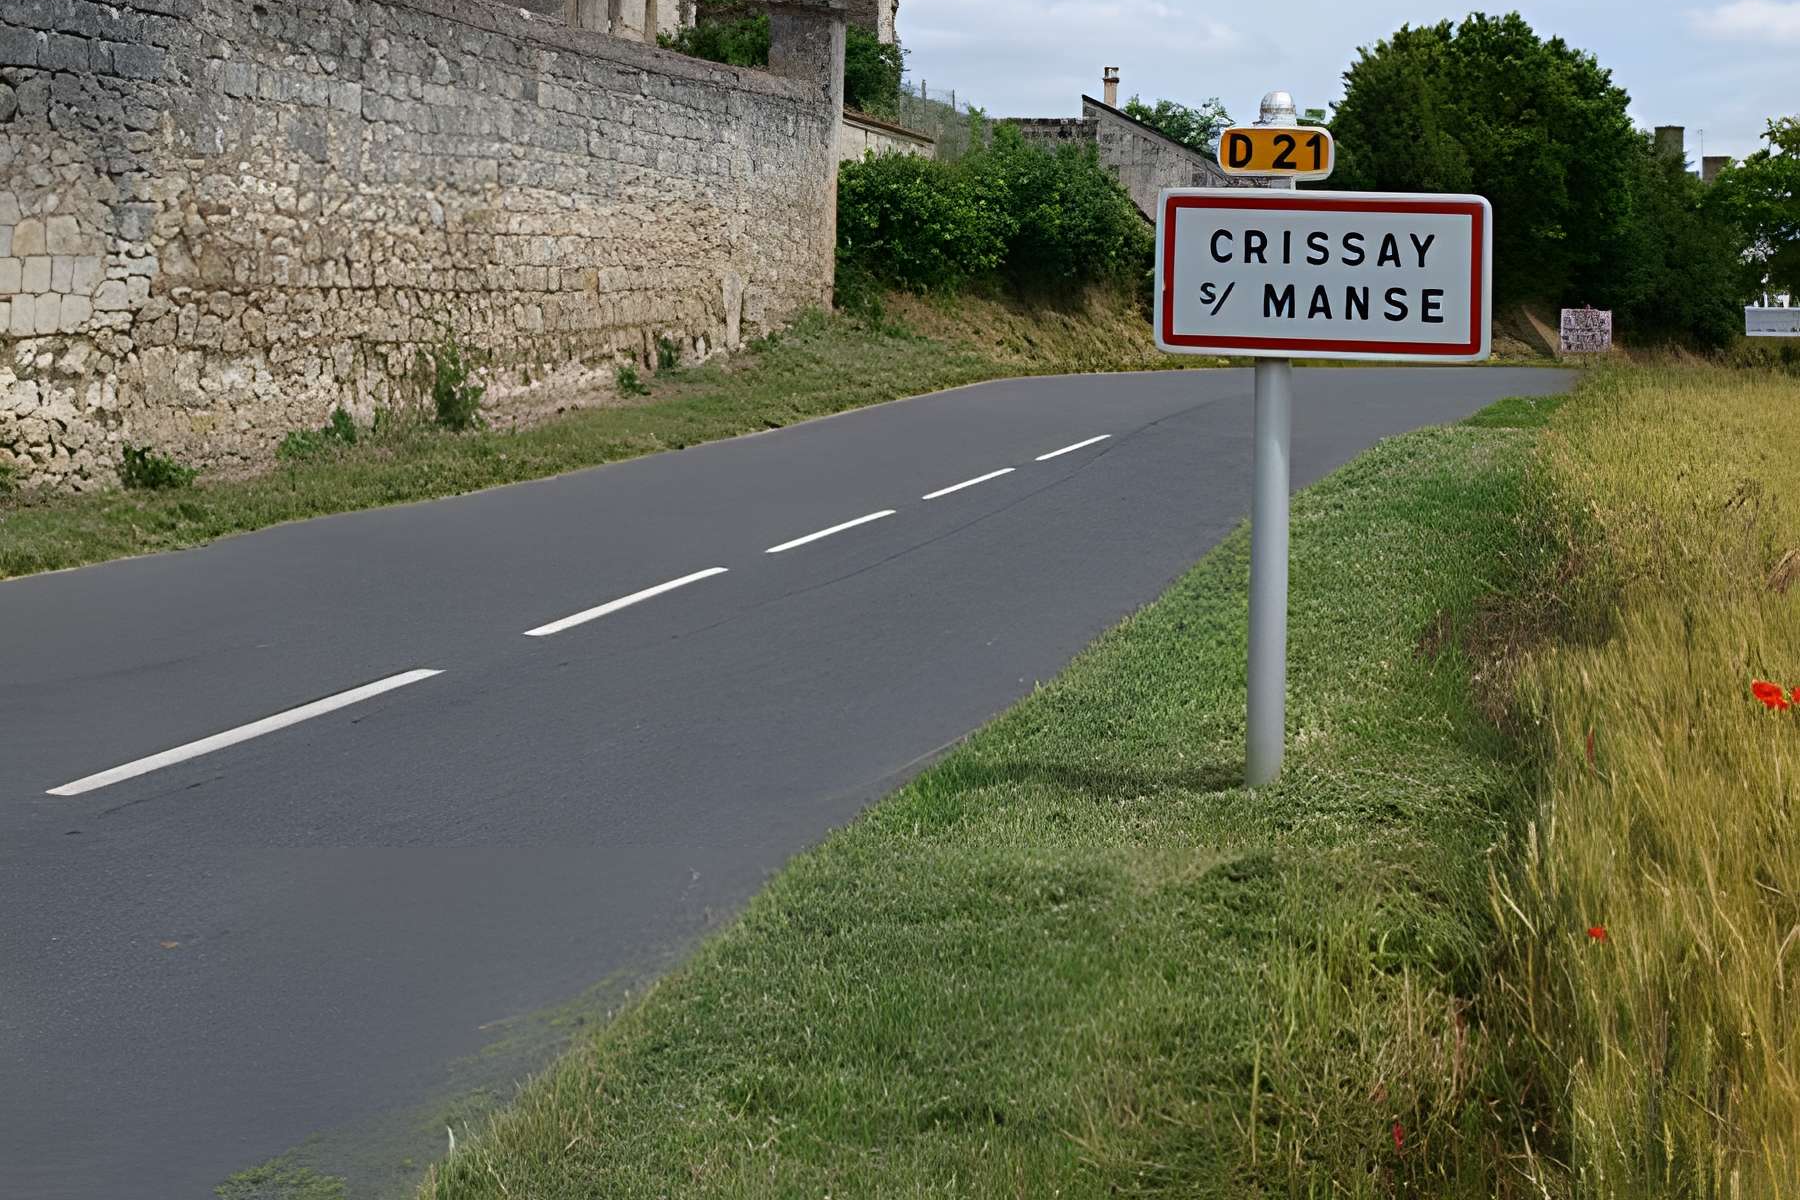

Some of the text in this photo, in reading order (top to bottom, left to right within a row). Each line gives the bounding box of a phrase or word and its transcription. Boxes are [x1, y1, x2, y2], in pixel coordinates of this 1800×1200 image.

[1228, 133, 1321, 170] D 21
[1209, 228, 1435, 268] CRISSAY
[1263, 283, 1444, 324] MANSE
